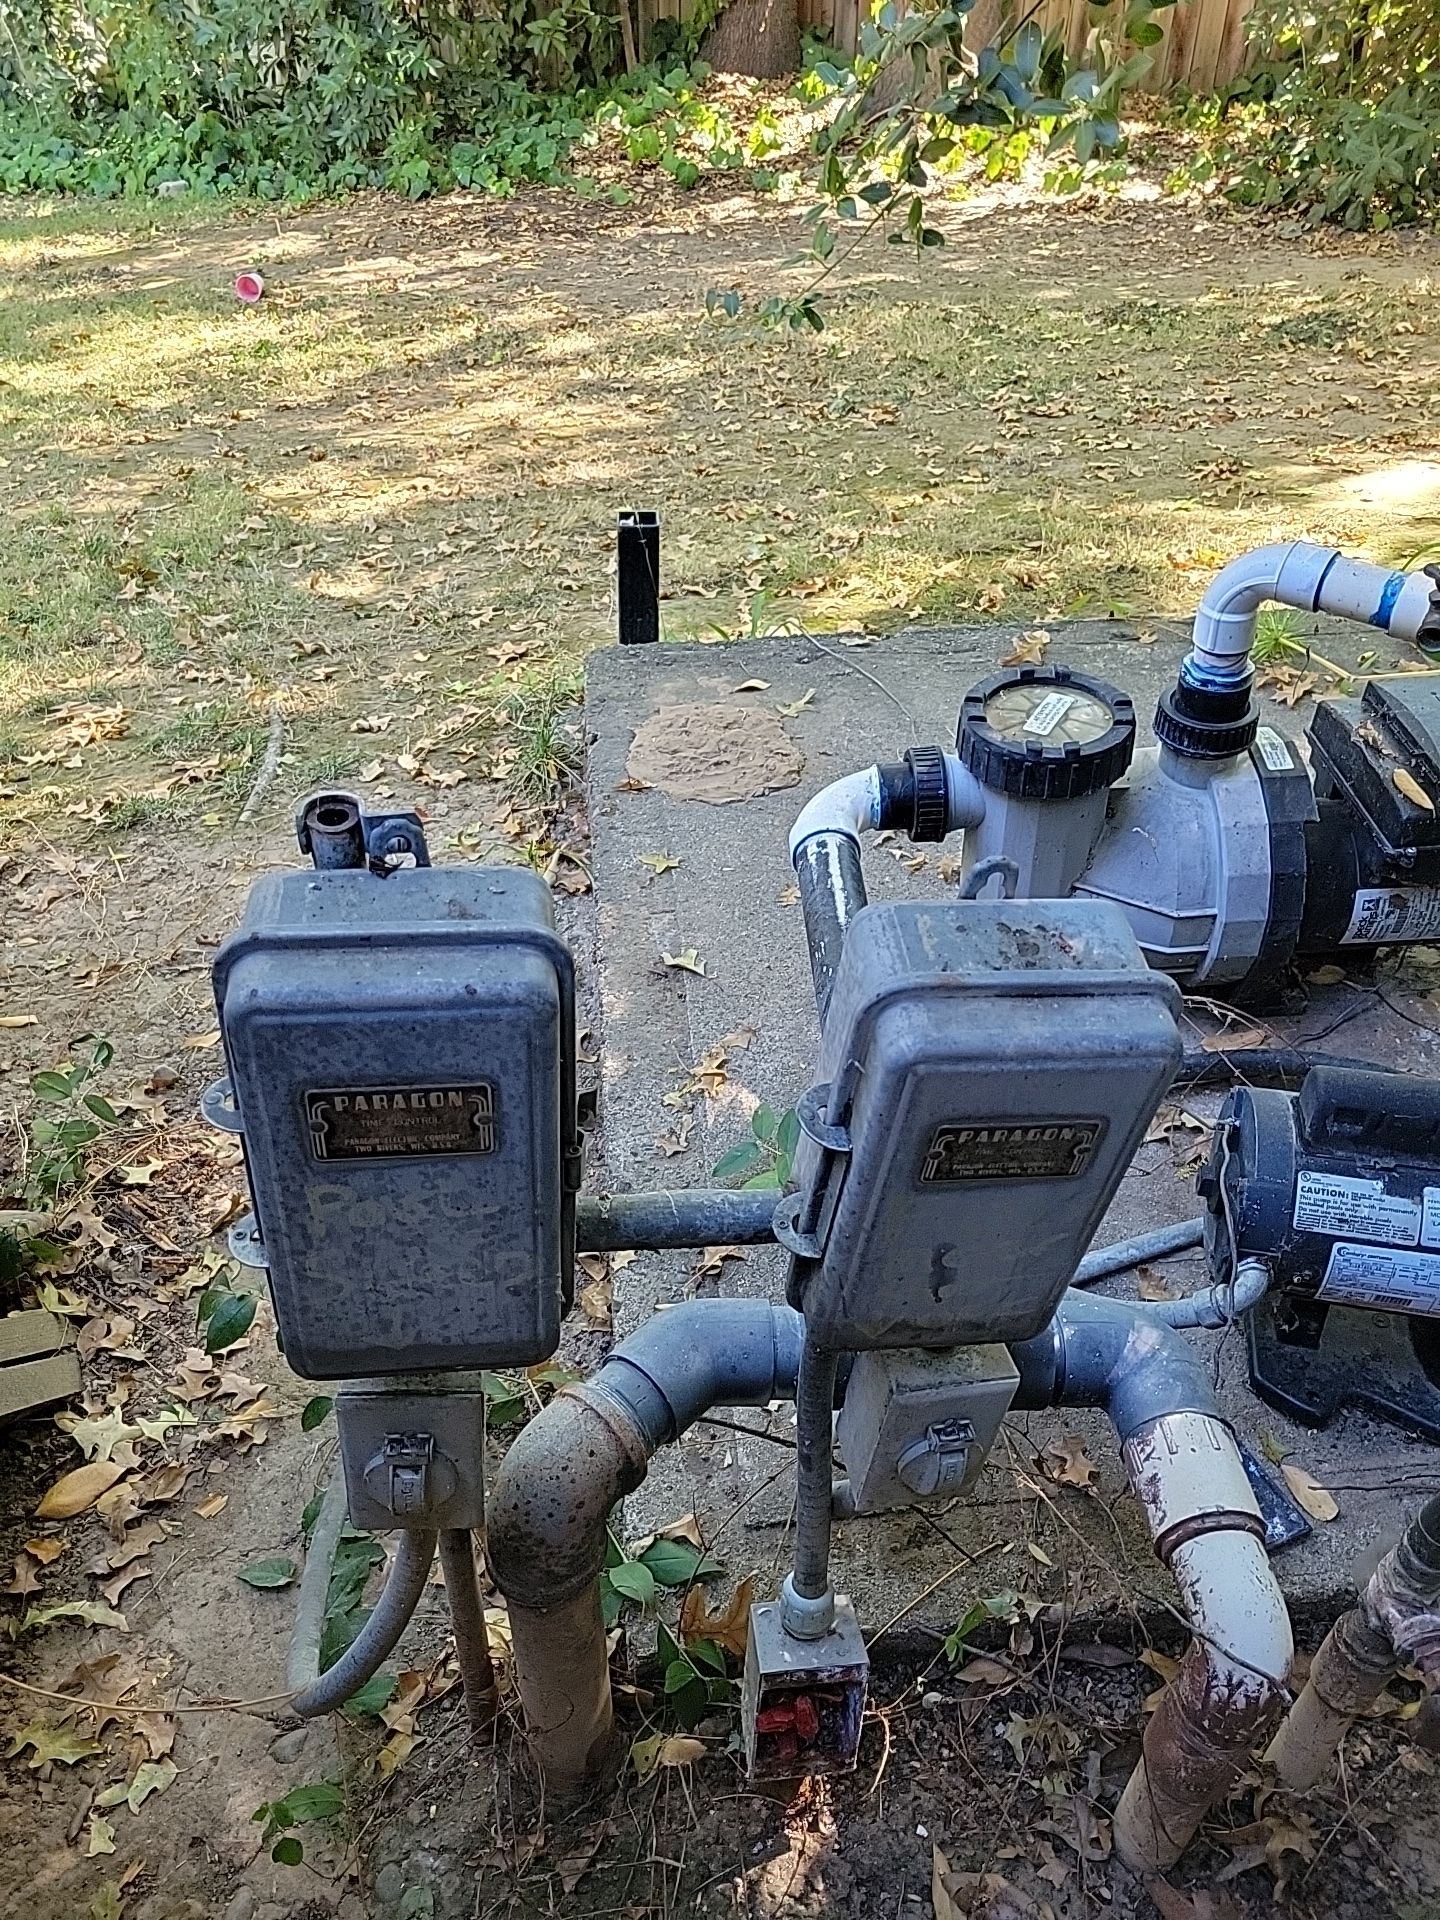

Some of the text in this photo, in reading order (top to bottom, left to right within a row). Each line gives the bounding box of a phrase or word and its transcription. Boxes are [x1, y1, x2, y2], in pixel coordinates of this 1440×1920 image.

[334, 1090, 463, 1112] PARAGON
[362, 1115, 442, 1128] TIME CONTROL
[344, 1137, 380, 1146] PARAGON
[425, 1133, 460, 1142] COMPANY
[958, 1127, 1075, 1144] PARAGON
[355, 1145, 372, 1153] TWO
[1300, 1185, 1349, 1199] CAUTION:
[1313, 1197, 1331, 1206] pump
[1340, 1198, 1349, 1206] for
[1363, 1201, 1377, 1210] with
[1378, 1205, 1418, 1217] permanently
[1326, 1202, 1344, 1212] pools
[1345, 1204, 1359, 1214] only
[1332, 1209, 1347, 1218] with
[1375, 1215, 1392, 1225] pools
